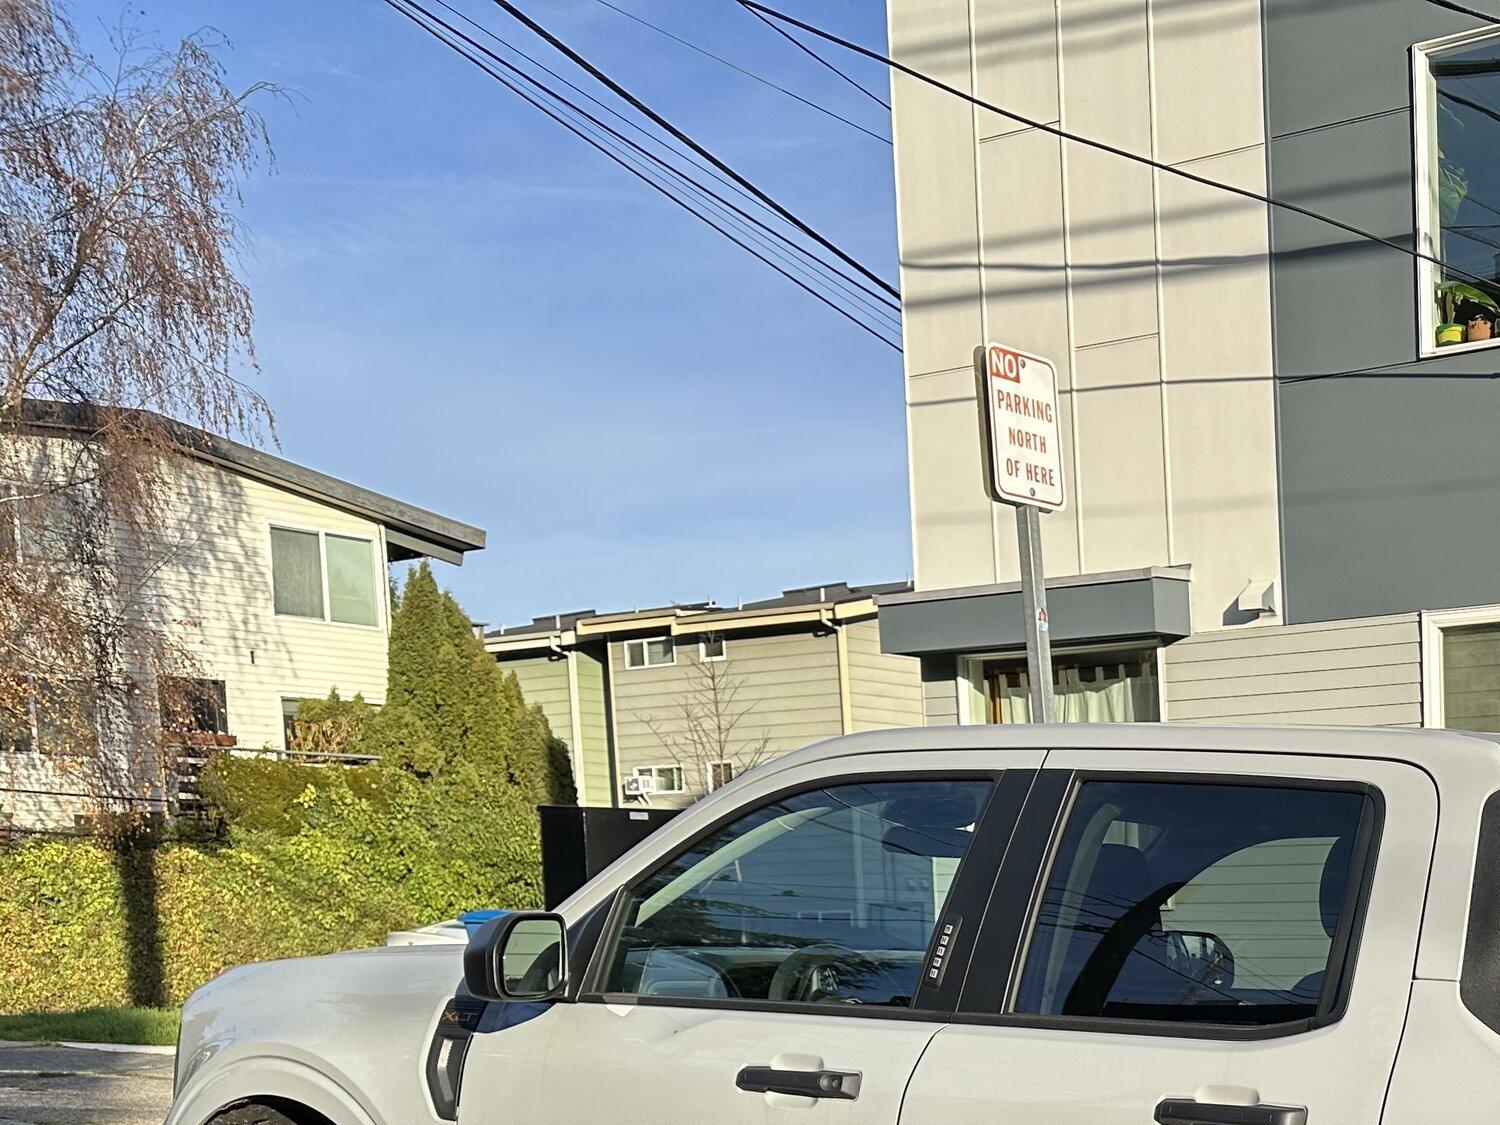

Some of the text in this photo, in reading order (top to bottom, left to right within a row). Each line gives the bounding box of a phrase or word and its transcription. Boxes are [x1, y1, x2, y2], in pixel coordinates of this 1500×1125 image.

[991, 350, 1017, 378] NO
[996, 389, 1053, 423] PARKING
[1008, 427, 1046, 454] NORTH
[1006, 458, 1055, 487] OF HERE
[441, 1010, 479, 1022] XLT
